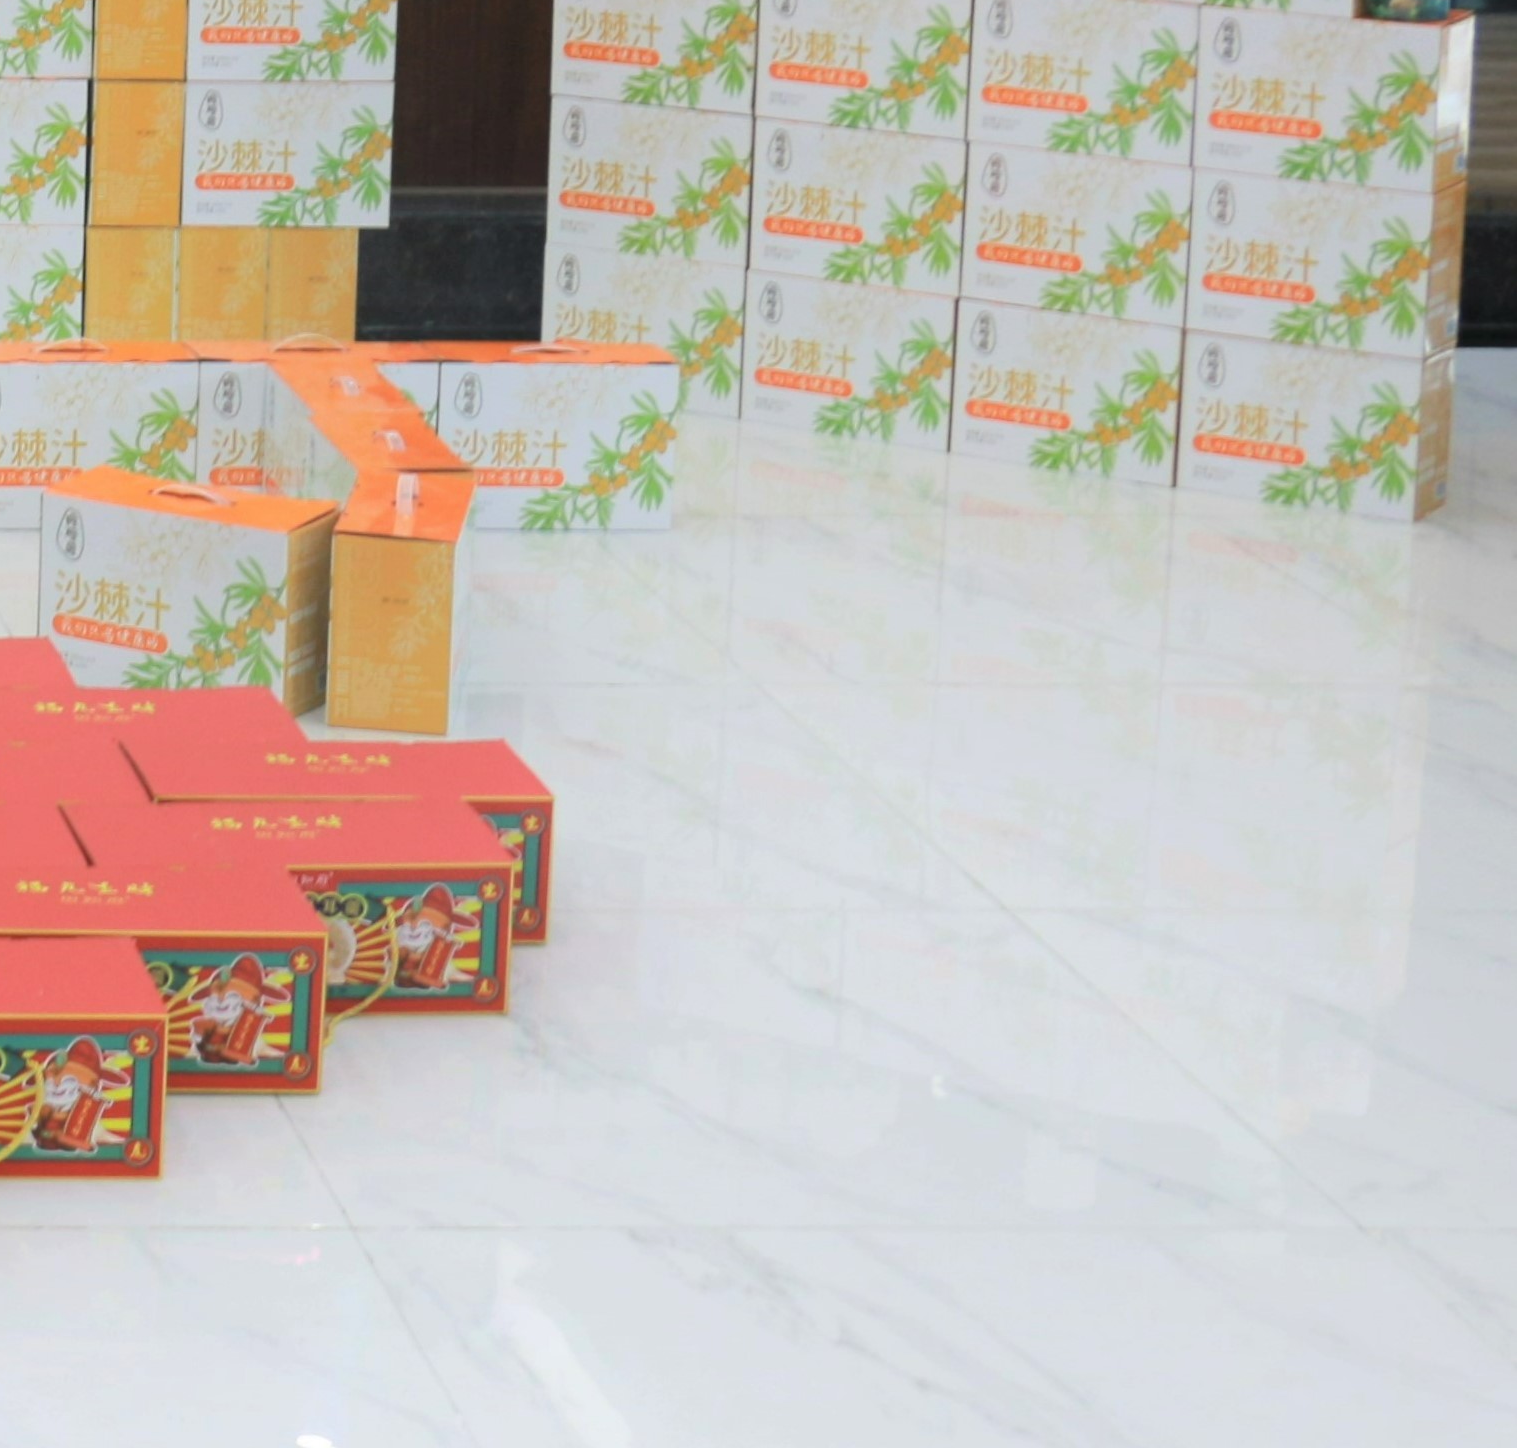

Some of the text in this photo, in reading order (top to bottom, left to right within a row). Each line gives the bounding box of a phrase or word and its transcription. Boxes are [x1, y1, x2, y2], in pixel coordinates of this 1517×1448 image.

[564, 10, 660, 48] 沙棘汁
[770, 30, 868, 70] 沙棘汁
[982, 51, 1088, 93] 沙棘汁
[1210, 75, 1322, 118] 沙棘汁
[196, 141, 294, 175] 沙棘汁
[560, 159, 655, 199] 沙棘汁
[764, 184, 863, 226] 沙棘汁
[977, 209, 1082, 253] 沙棘汁
[1203, 237, 1315, 282] 沙棘汁
[756, 337, 853, 379] 沙棘汁
[966, 366, 1071, 410] 沙棘汁
[1194, 398, 1305, 444] 沙棘汁
[452, 428, 567, 467] 沙棘汁
[53, 577, 168, 627] 沙棘汁
